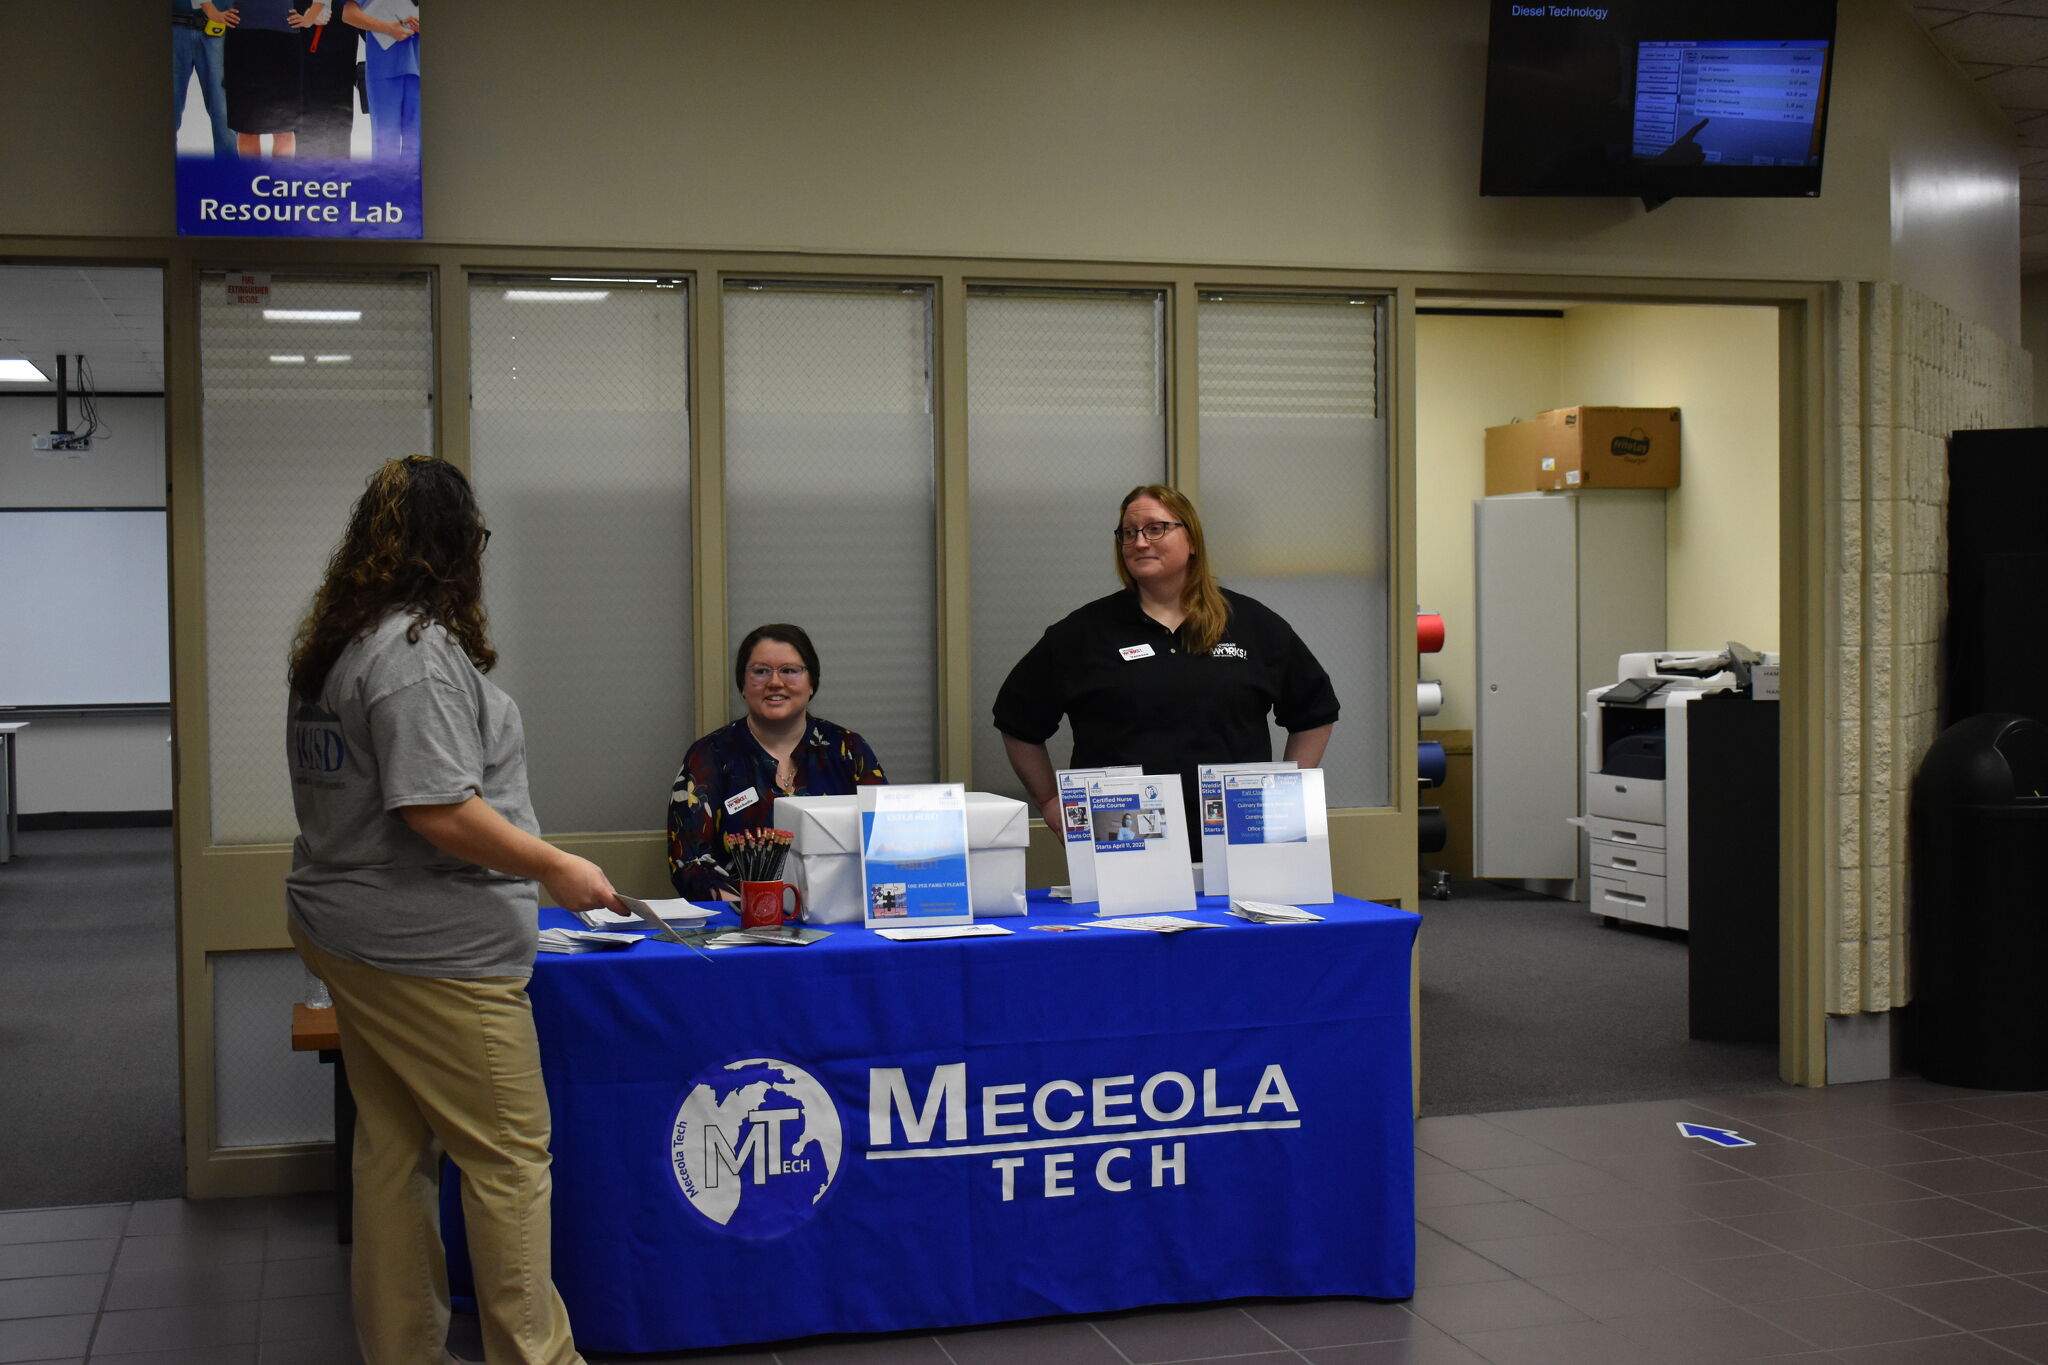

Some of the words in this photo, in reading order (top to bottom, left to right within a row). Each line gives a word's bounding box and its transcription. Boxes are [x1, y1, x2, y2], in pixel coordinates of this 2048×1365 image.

[1512, 5, 1545, 16] Diesel
[1548, 6, 1608, 20] Technology
[252, 175, 352, 199] Career
[200, 199, 339, 222] Resource
[350, 201, 403, 224] Lab
[228, 285, 269, 295] EXTINGUISHER
[241, 276, 256, 285] FIRE
[237, 296, 260, 304] INSIDE
[869, 1062, 1300, 1146] MECEOLA
[673, 1120, 688, 1148] Tech
[673, 1151, 699, 1198] Meceola
[992, 1142, 1186, 1201] TECH
